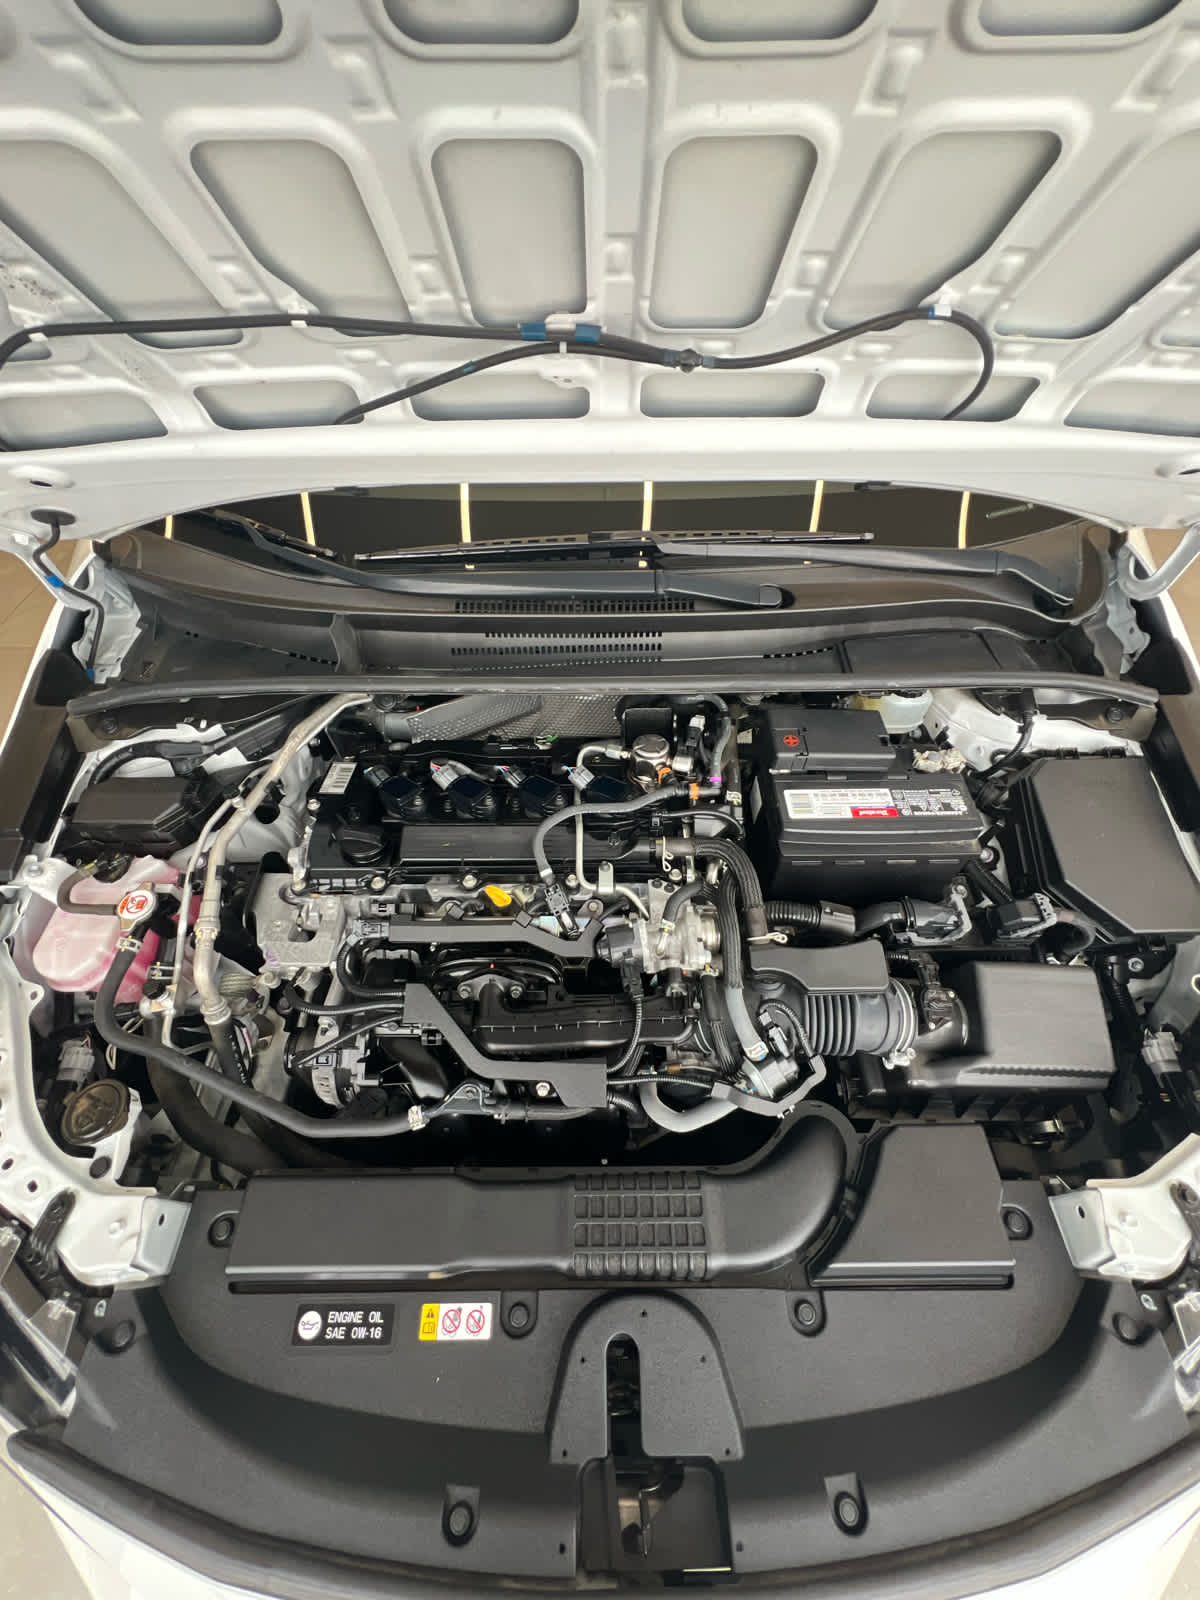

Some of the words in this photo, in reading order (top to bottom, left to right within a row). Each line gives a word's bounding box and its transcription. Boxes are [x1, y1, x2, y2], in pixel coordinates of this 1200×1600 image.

[328, 1311, 364, 1323] ENGINE
[369, 1311, 384, 1323] OIL
[325, 1327, 346, 1339] SAE
[351, 1327, 382, 1339] 0W-16
